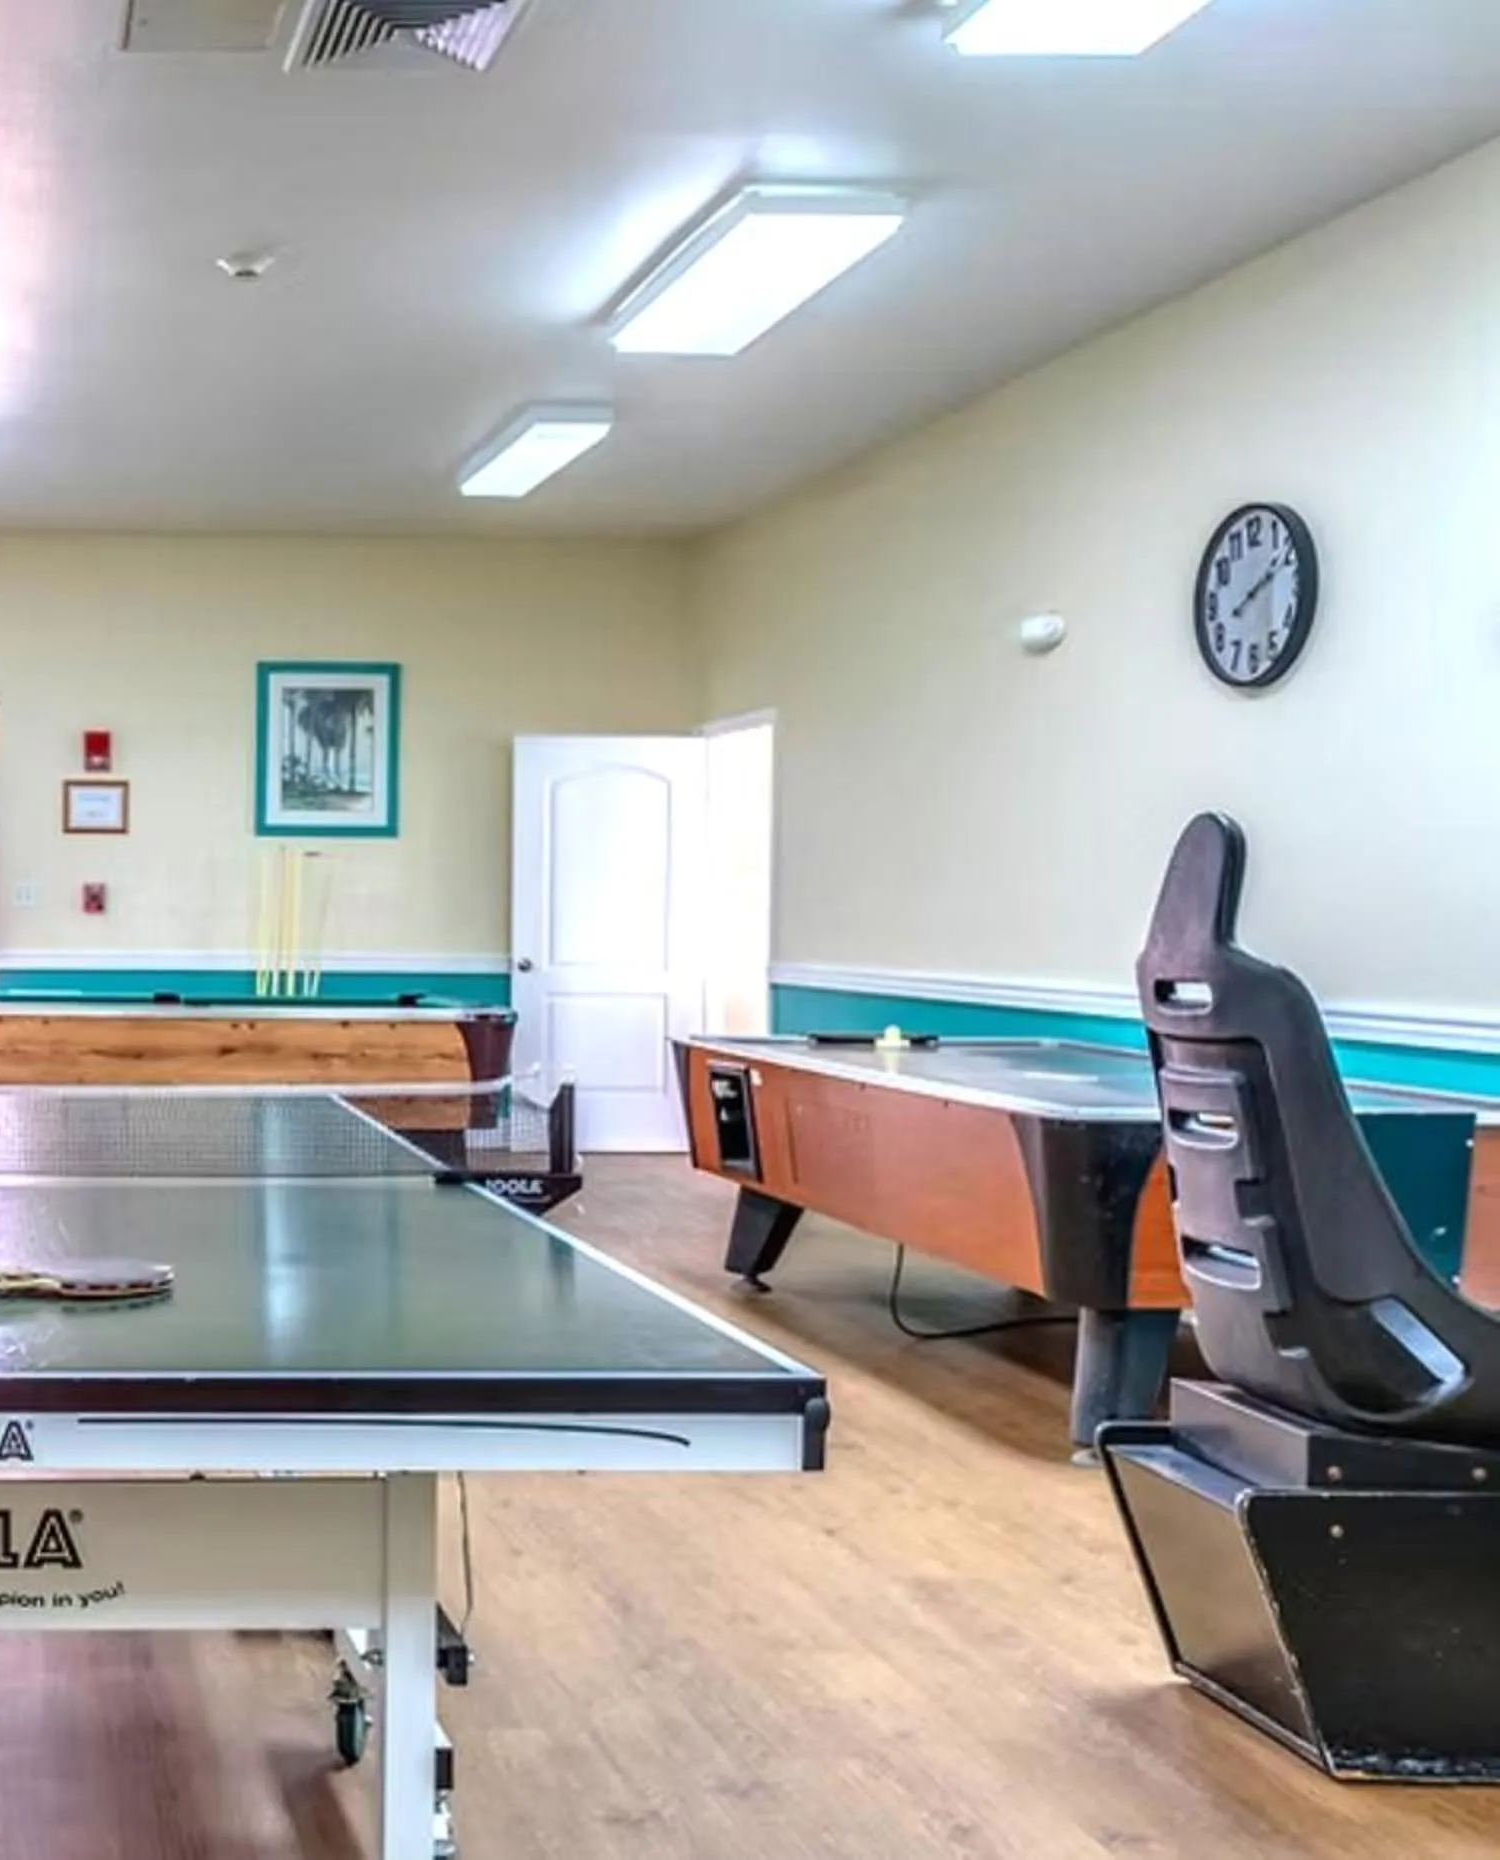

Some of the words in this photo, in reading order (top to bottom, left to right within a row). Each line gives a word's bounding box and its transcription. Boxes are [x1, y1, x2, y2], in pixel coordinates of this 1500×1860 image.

[1229, 531, 1243, 561] 11
[1247, 516, 1262, 547] 12
[1230, 639, 1243, 671] 7
[51, 1593, 73, 1607] in
[79, 1581, 126, 1608] you!
